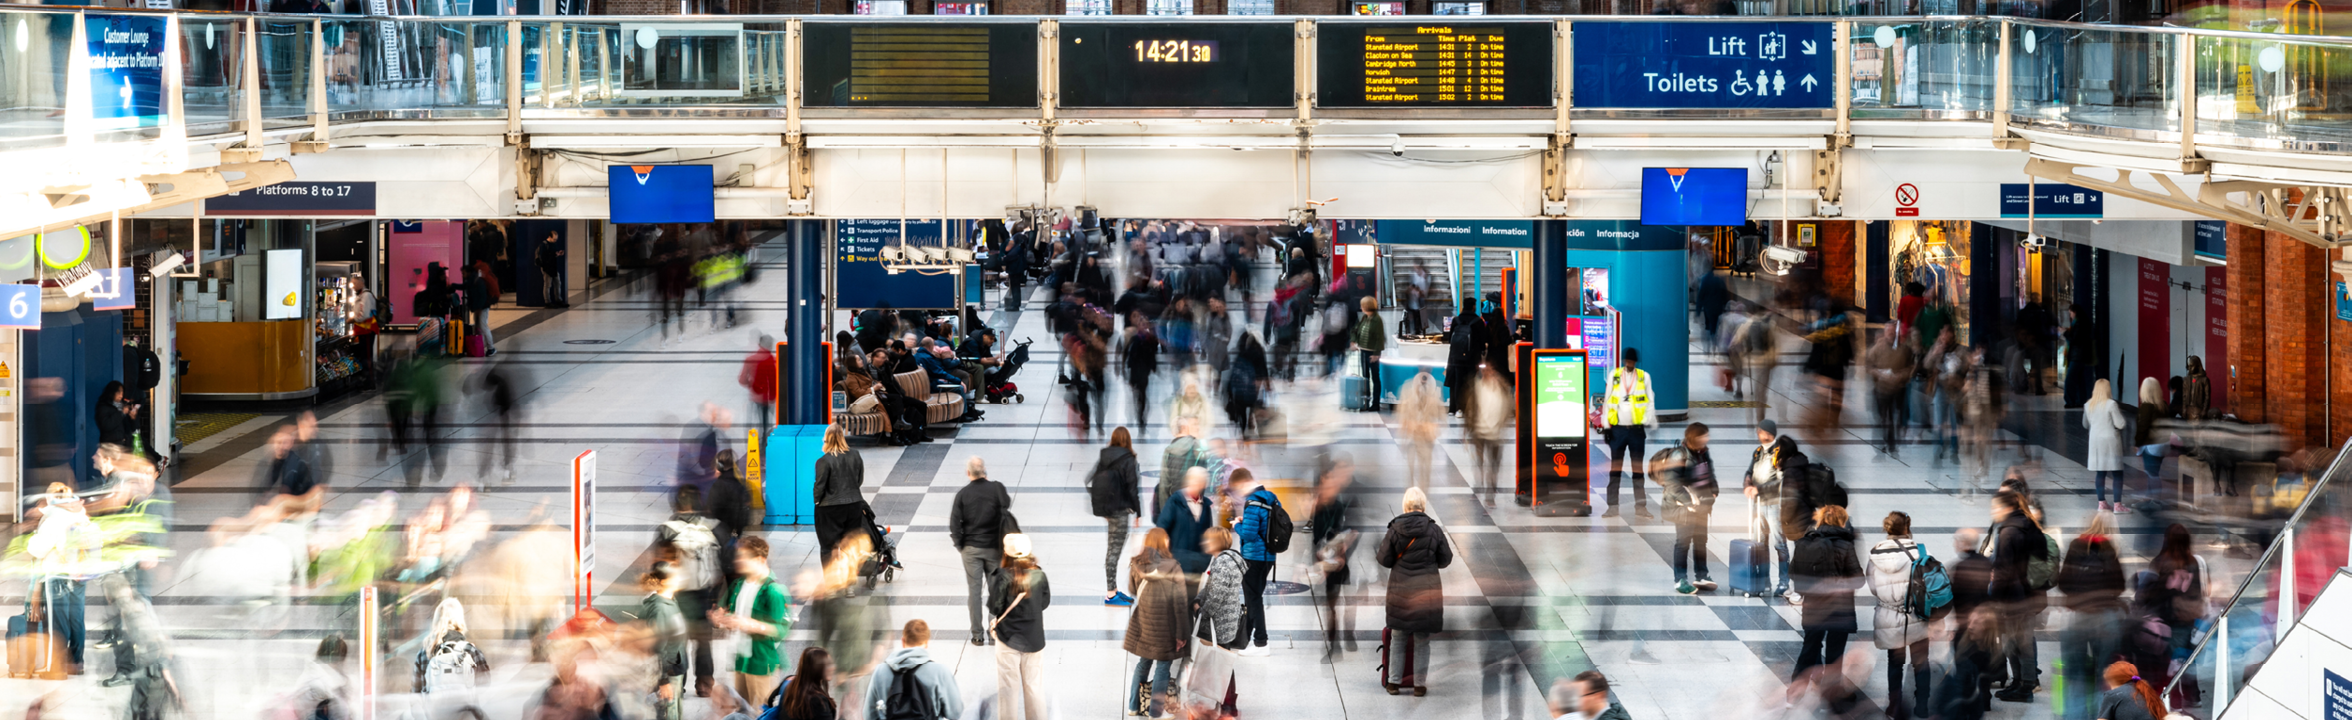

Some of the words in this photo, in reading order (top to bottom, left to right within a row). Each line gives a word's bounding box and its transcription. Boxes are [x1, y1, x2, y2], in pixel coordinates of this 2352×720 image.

[104, 27, 130, 44] Customer
[130, 28, 149, 48] Lounge
[1708, 36, 1746, 56] Lift
[107, 52, 129, 72] adjacent
[130, 54, 135, 68] to
[136, 52, 157, 68] Platform
[158, 51, 165, 68] 10
[1135, 40, 1188, 62] 14:21
[1643, 72, 1718, 93] Toilets
[256, 184, 308, 195] Platforms
[311, 186, 319, 196] 8
[321, 186, 334, 196] to
[336, 185, 351, 196] 17
[2054, 194, 2070, 203] Lift
[1424, 224, 1471, 234] Informazioni
[1482, 226, 1527, 236] Information
[1596, 230, 1640, 240] Informacja
[9, 292, 28, 319] 6
